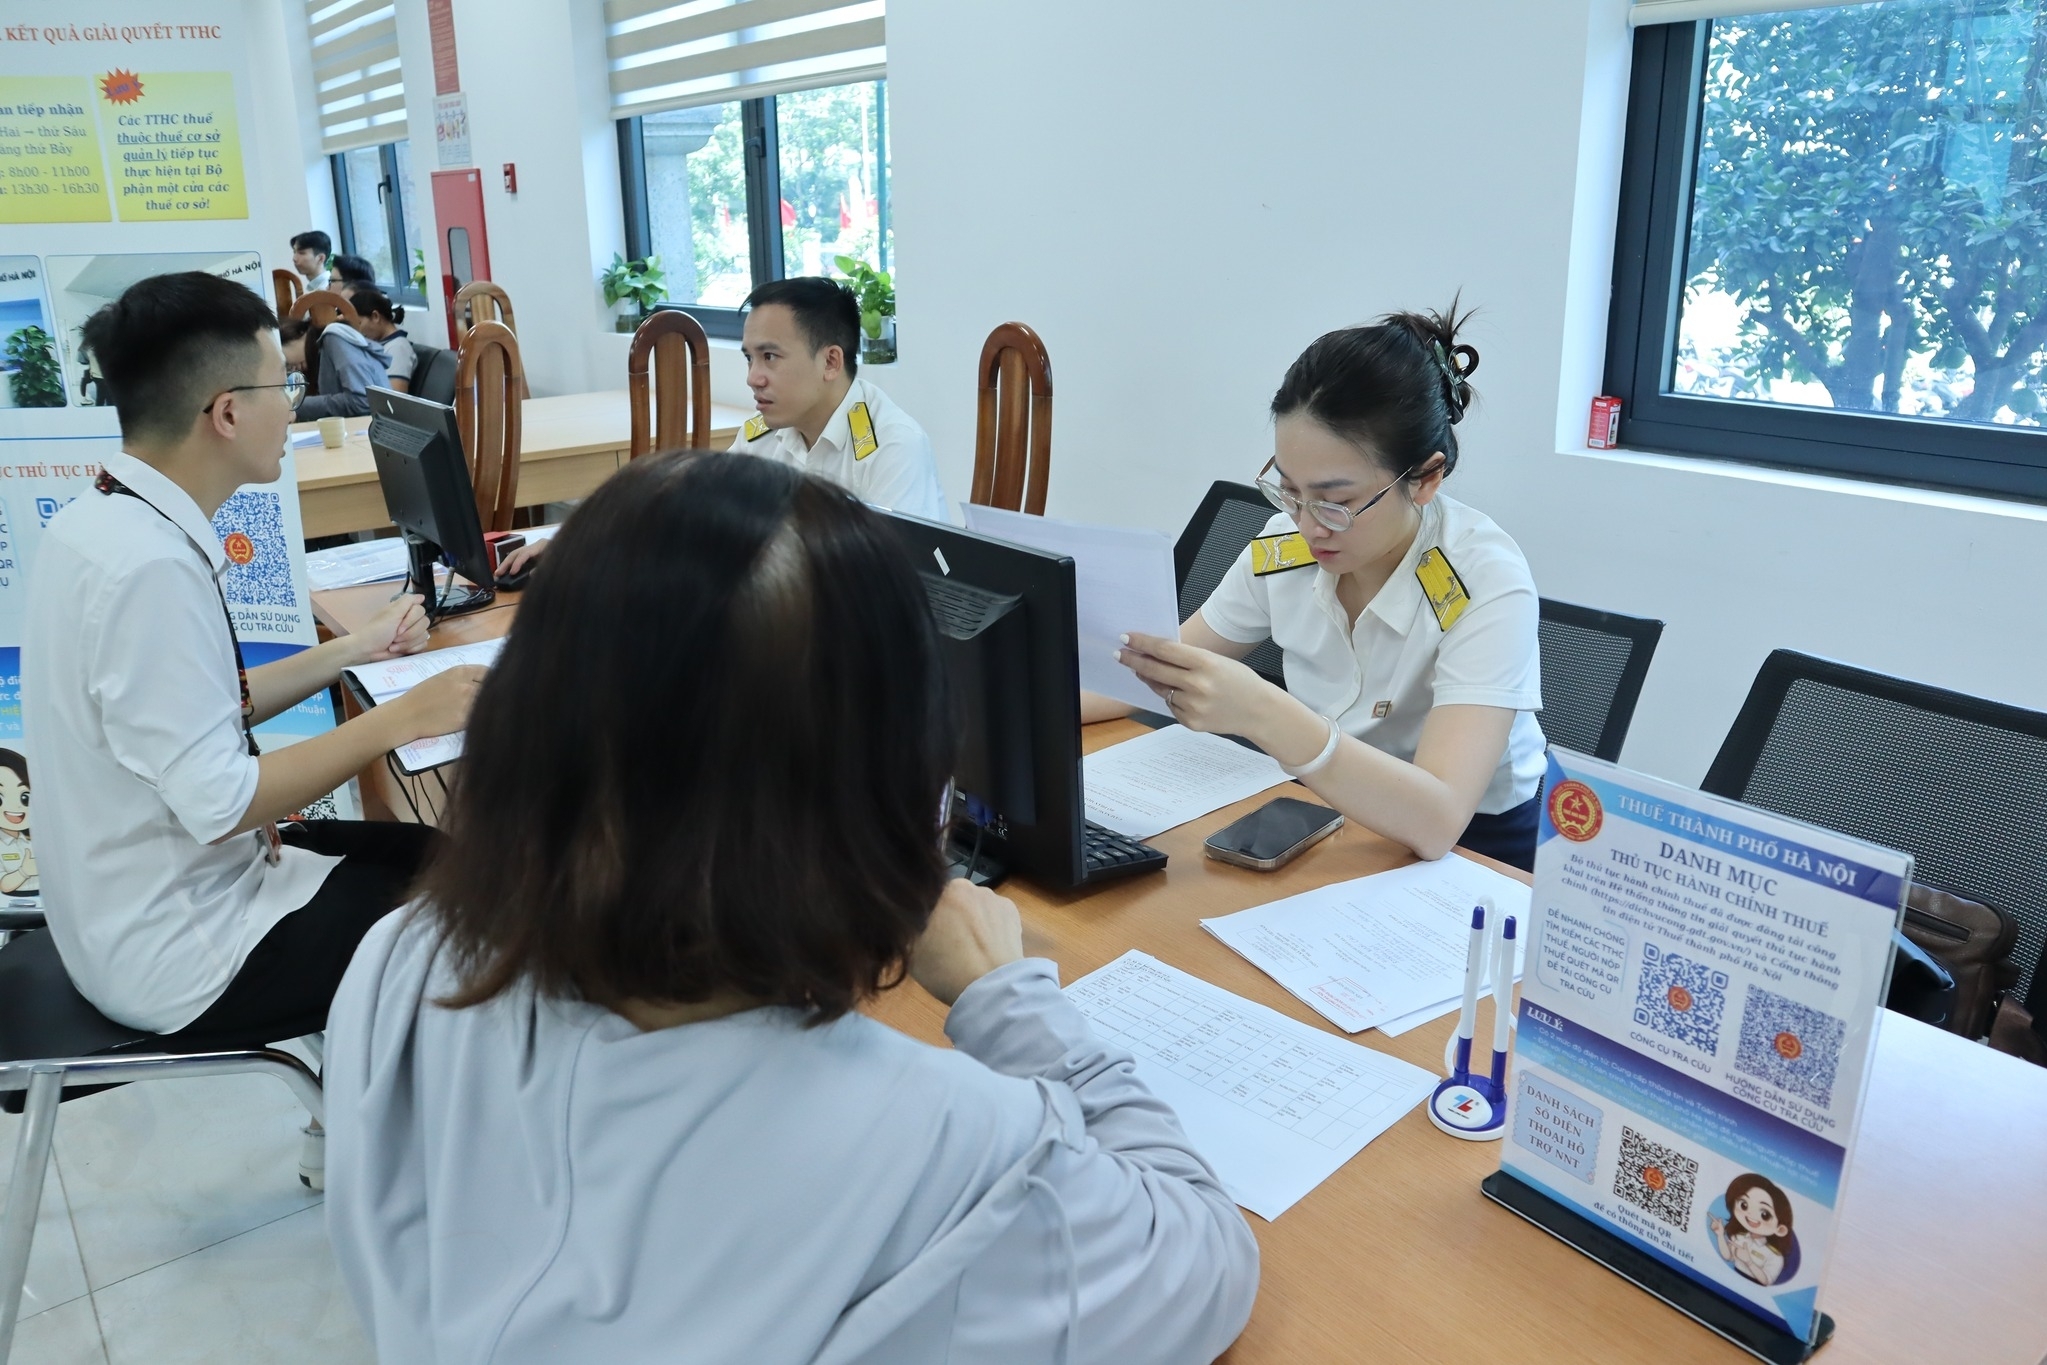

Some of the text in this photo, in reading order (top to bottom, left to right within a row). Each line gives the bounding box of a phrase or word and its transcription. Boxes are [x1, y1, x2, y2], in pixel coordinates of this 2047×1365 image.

[5, 22, 222, 45] KẾT QUẢ GIẢI QUYẾT TTHC
[17, 103, 84, 117] tiếp nhận
[119, 112, 213, 125] Các TTHC thuế
[63, 125, 87, 137] Sáu
[118, 129, 220, 143] thuộc thuế cơ sở
[124, 148, 153, 162] quản
[171, 147, 194, 160] tiếp
[199, 149, 219, 160] tục
[125, 164, 222, 178] thực hiện tại Bộ
[9, 167, 39, 178] 8h00
[52, 166, 90, 177] 11h00
[12, 183, 49, 194] 13h30
[62, 183, 99, 194] 16h30
[124, 181, 229, 196] phận một cửa các
[146, 198, 172, 210] thuế
[176, 201, 189, 209] cơ
[15, 461, 47, 477] THỦ
[51, 465, 81, 480] TỤC
[238, 608, 258, 620] DẪN
[261, 610, 273, 621] SỬ
[275, 613, 300, 624] DỤNG
[240, 622, 253, 632] CỤ
[256, 623, 274, 632] TRA
[275, 621, 294, 633] CỨU
[1618, 794, 1665, 821] THUẾ
[1669, 811, 1734, 845] THÀNH
[1738, 835, 1778, 859] PHỐ
[1783, 848, 1812, 872] HÀ
[1817, 860, 1858, 886] NỘI
[1660, 841, 1778, 896] DANH MỤC
[1570, 854, 1583, 865] Bộ
[1586, 860, 1602, 872] thủ
[1605, 868, 1621, 880] tục
[1623, 873, 1648, 889] hành
[1651, 884, 1680, 901] chính
[1683, 896, 1708, 911] thuế
[1726, 913, 1752, 929] được
[1788, 933, 1804, 947] tải
[1611, 849, 1830, 938] THỦ TỤC HÀNH CHÍNH THUẾ
[1548, 908, 1626, 946] ĐỂ NHANH CHÓNG
[1561, 876, 1588, 892] chính
[1755, 951, 1767, 962] và
[1770, 956, 1801, 976] Cổng
[1803, 969, 1839, 991] thông
[1563, 864, 1841, 976] khai trên Hệ thống thông tin giải quyết thủ tục hành
[1545, 919, 1624, 960] TÌM KIẾM CÁC TTHC
[1602, 905, 1782, 982] tin điện tử Thuế thành phố Hà Nội
[1543, 945, 1620, 985] THUẾ QUÉT MÃ QR
[1572, 944, 1599, 962] NGƯỜI
[1601, 957, 1621, 970] NỘP
[1547, 960, 1612, 995] ĐỂ TẢI CÔNG CỤ
[1559, 978, 1595, 1000] TRA CỨU
[1527, 1006, 1552, 1025] LƯU
[1630, 1031, 1712, 1073] CÔNG CỤ TRA CỨU
[1725, 1072, 1762, 1095] HƯỚNG
[1764, 1089, 1786, 1105] DẪN
[1526, 1085, 1594, 1128] DANH SÁCH
[1535, 1105, 1582, 1138] SỐ ĐIỆN
[1733, 1086, 1761, 1105] CÔNG
[1780, 1106, 1799, 1121] TRA
[1801, 1117, 1824, 1133] CỨU
[1528, 1118, 1586, 1156] THOẠI HỖ
[1529, 1134, 1581, 1169] TRỢ NNT
[1593, 1200, 1694, 1262] để có thông tin chi tiết
[1617, 1204, 1672, 1240] Quét mã QR
